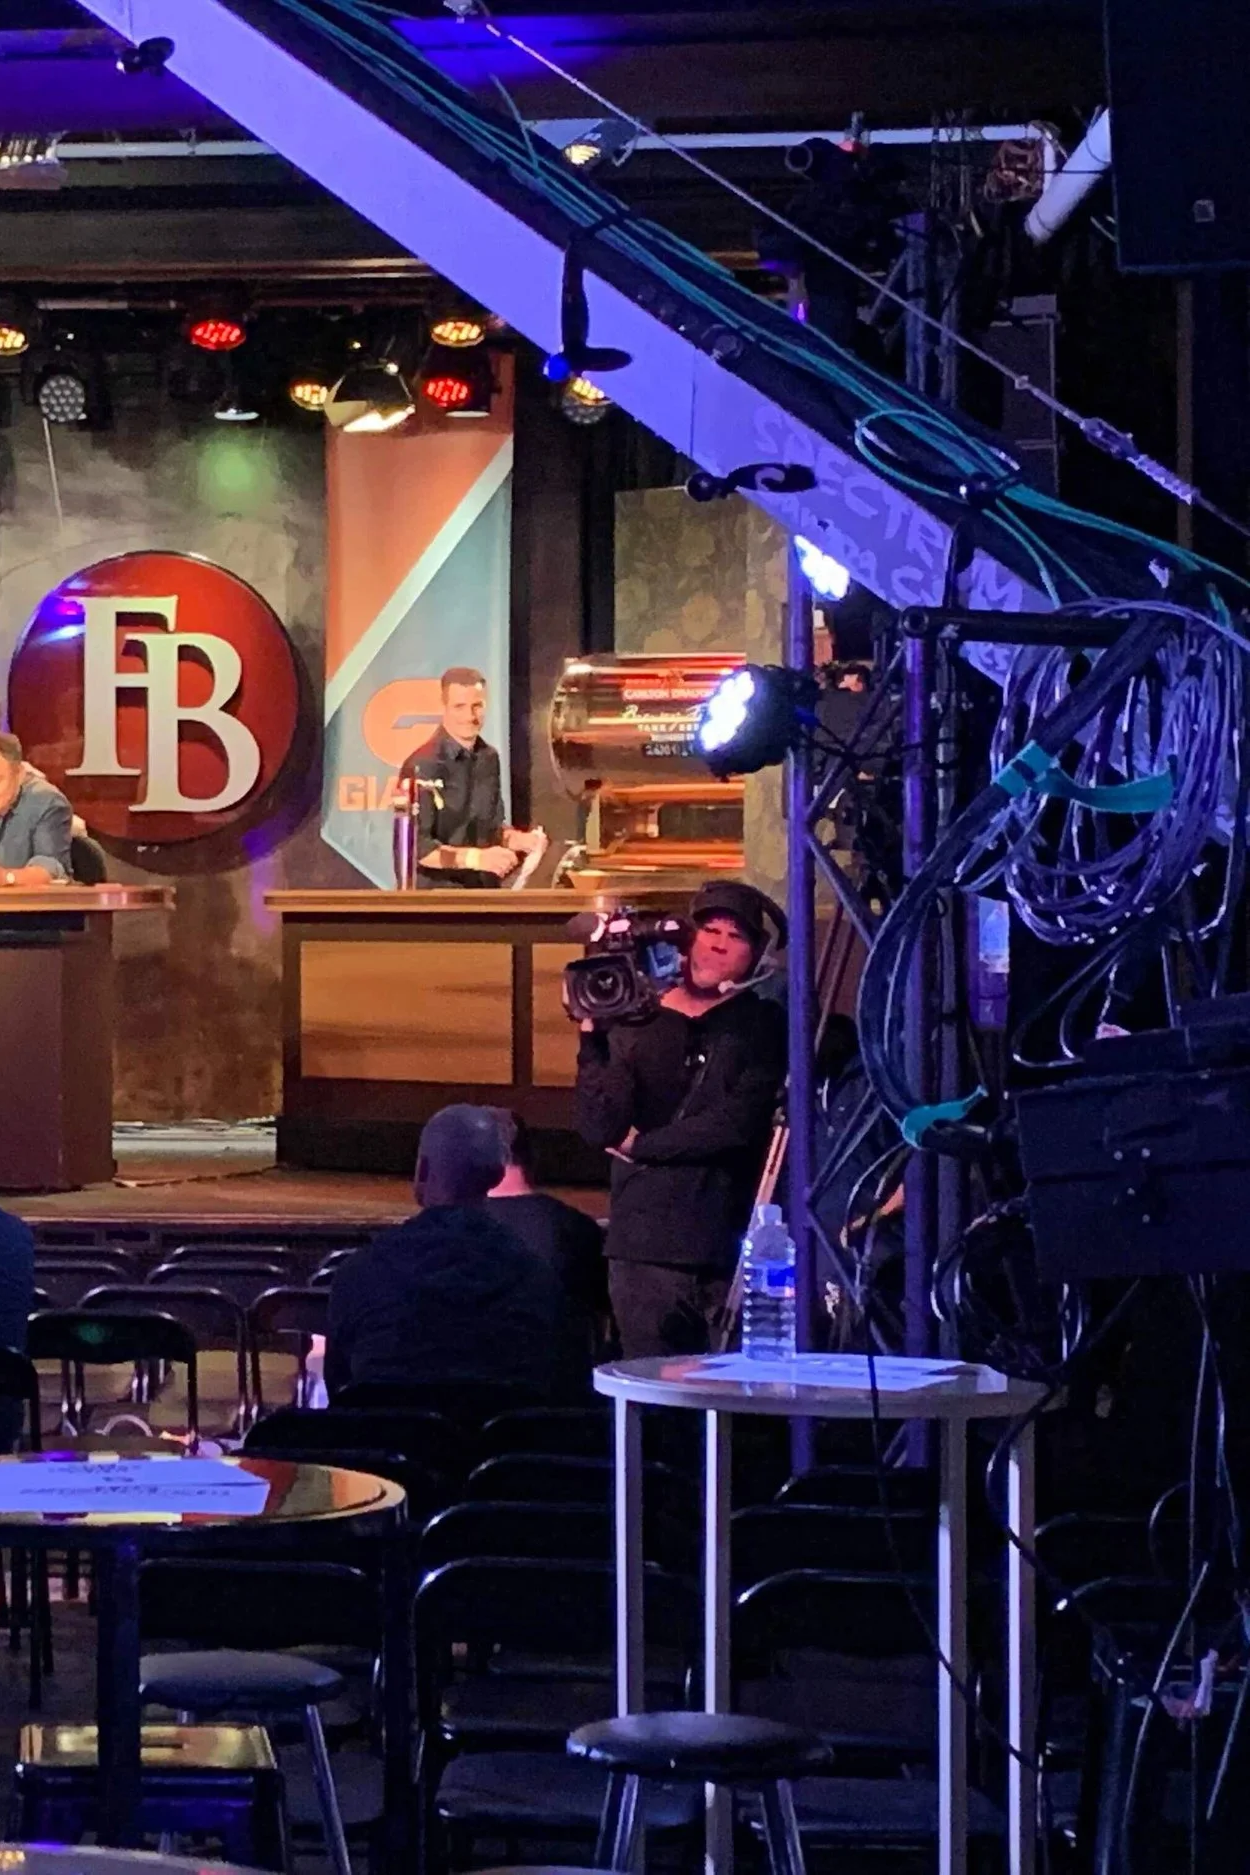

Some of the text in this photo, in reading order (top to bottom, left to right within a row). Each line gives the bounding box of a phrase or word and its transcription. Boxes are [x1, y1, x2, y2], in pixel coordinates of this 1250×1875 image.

[753, 407, 1023, 611] SPECTRM
[62, 595, 261, 813] FB
[338, 775, 400, 812] GIA
